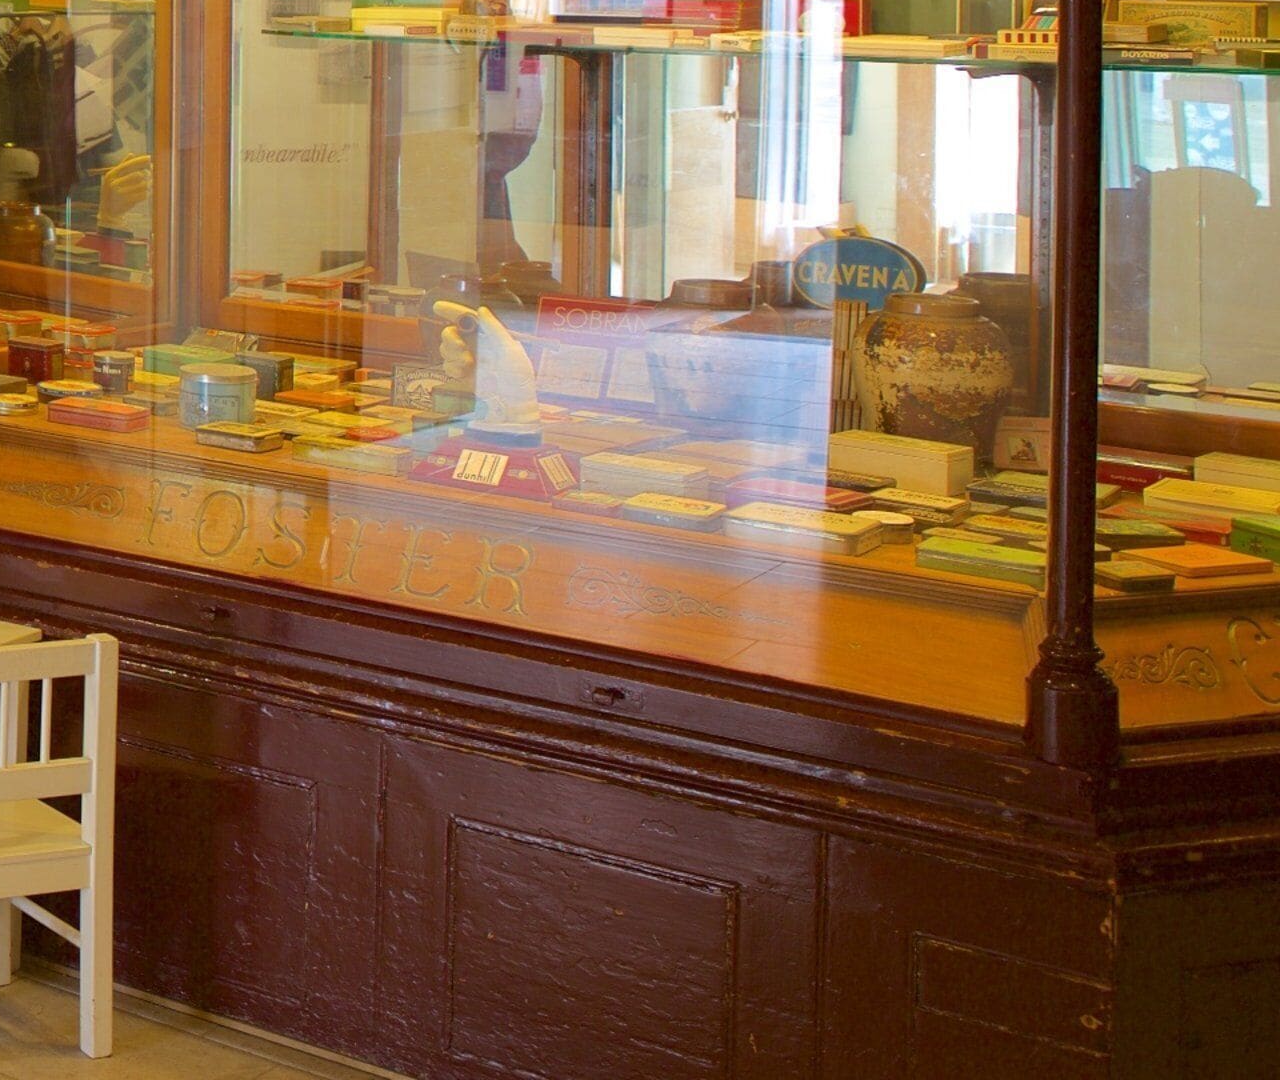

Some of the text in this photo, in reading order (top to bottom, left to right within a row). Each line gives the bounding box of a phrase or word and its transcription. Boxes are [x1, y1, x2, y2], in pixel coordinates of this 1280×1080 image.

[798, 260, 889, 289] CRAVEN
[456, 452, 501, 483] dunhill
[136, 476, 536, 618] FOSTER
